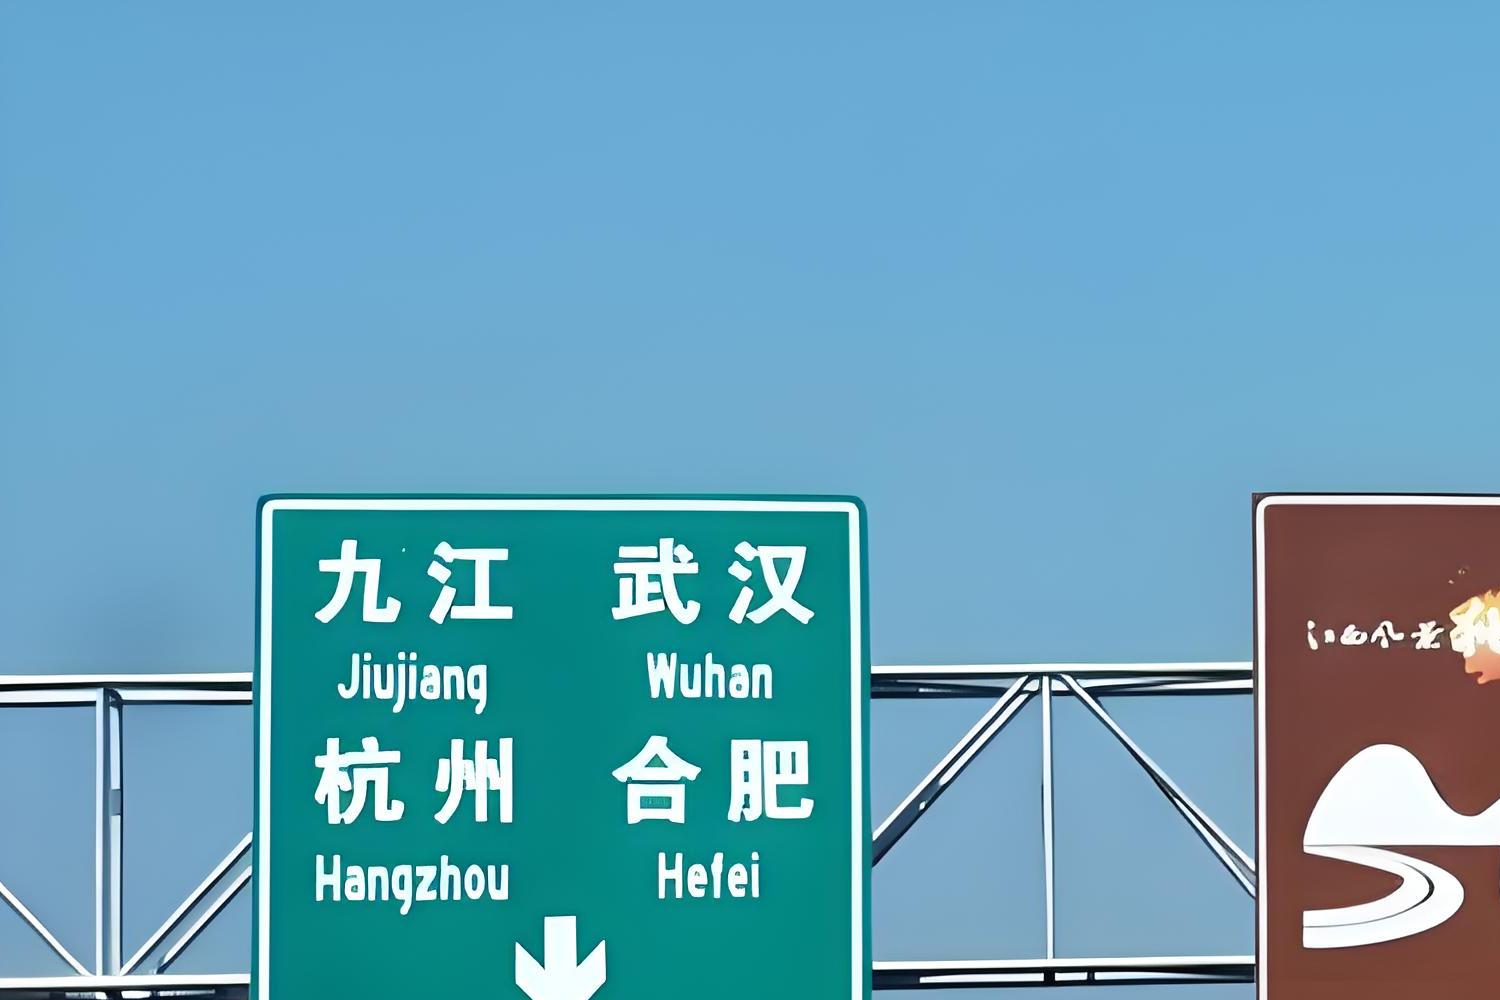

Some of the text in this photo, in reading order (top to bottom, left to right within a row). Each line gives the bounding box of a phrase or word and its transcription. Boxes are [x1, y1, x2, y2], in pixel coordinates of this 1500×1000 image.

[314, 539, 513, 625] 九江
[611, 537, 815, 625] 武汉
[337, 651, 487, 715] Jiujiang
[646, 652, 773, 699] Wuhan
[314, 736, 513, 825] 杭州
[611, 735, 814, 825] 合肥
[315, 854, 509, 916] Hangzhou
[658, 851, 760, 899] Hefei
